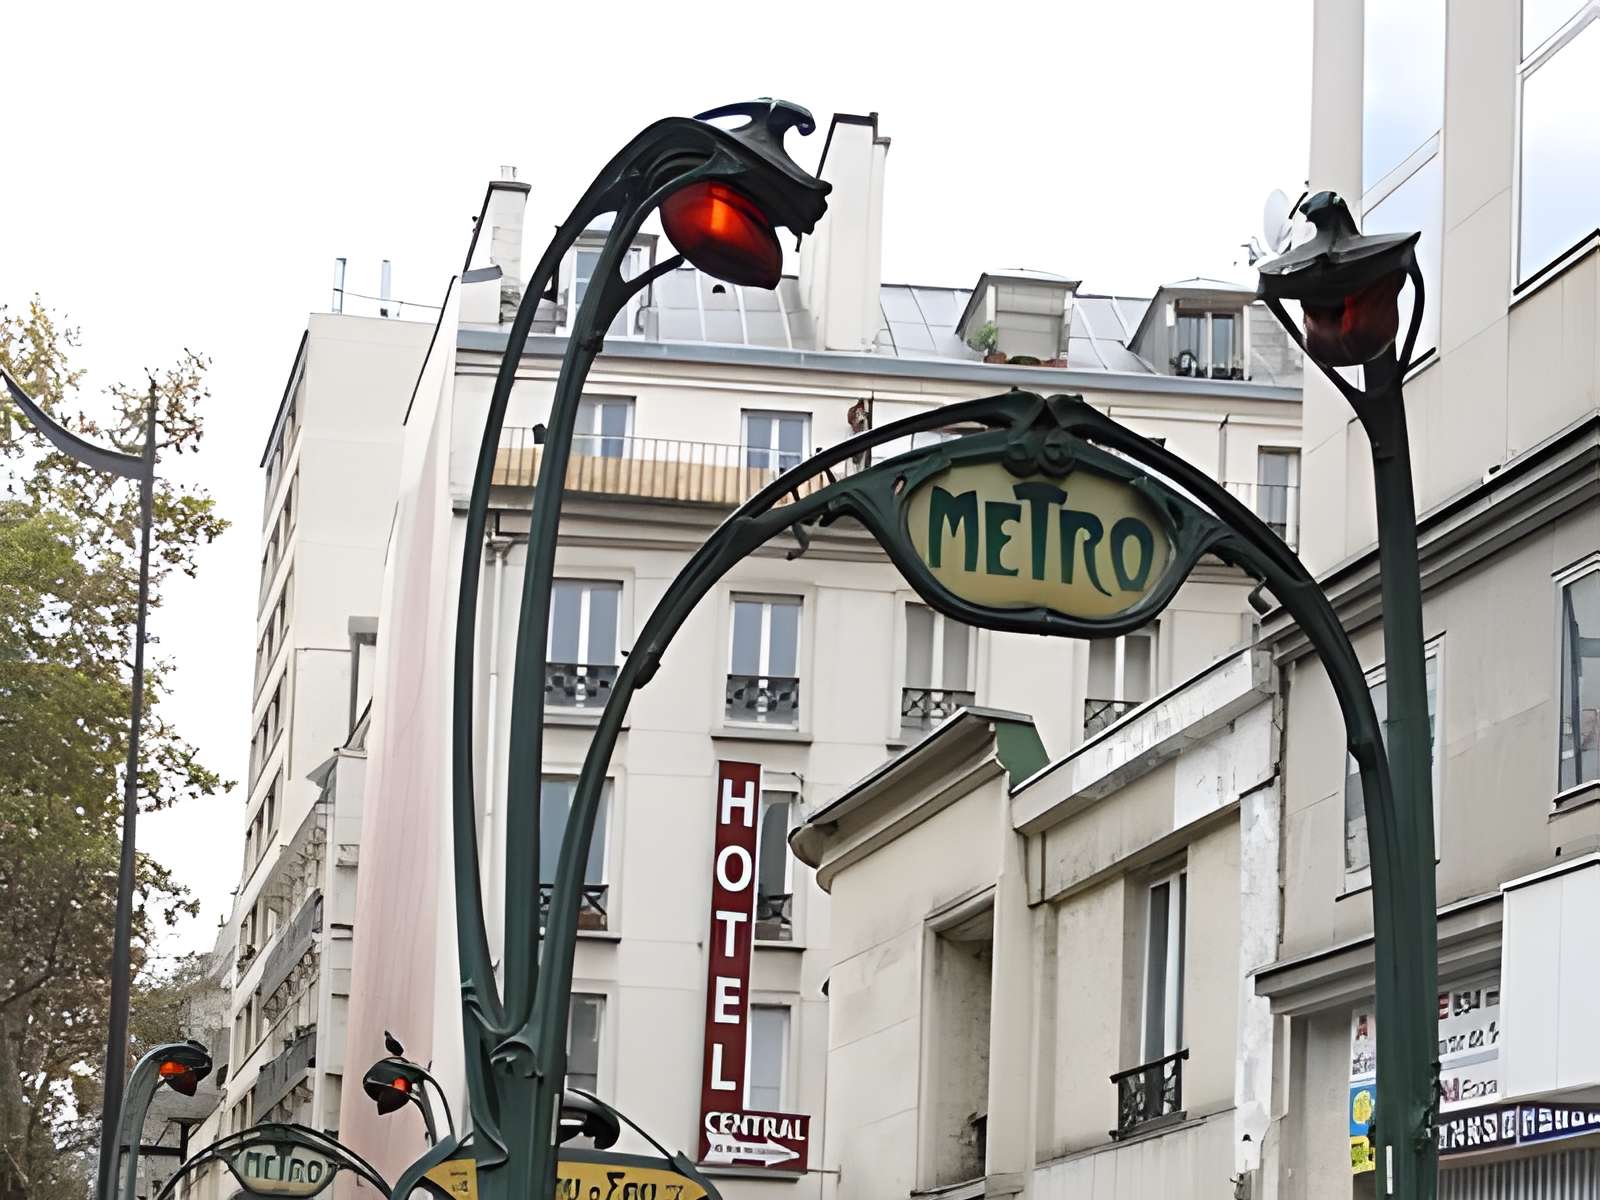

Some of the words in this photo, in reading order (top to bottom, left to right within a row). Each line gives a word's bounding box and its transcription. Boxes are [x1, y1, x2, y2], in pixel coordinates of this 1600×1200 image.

[929, 481, 1154, 597] METRO
[710, 778, 756, 1091] HOTEL
[704, 1111, 806, 1140] CENTRAL
